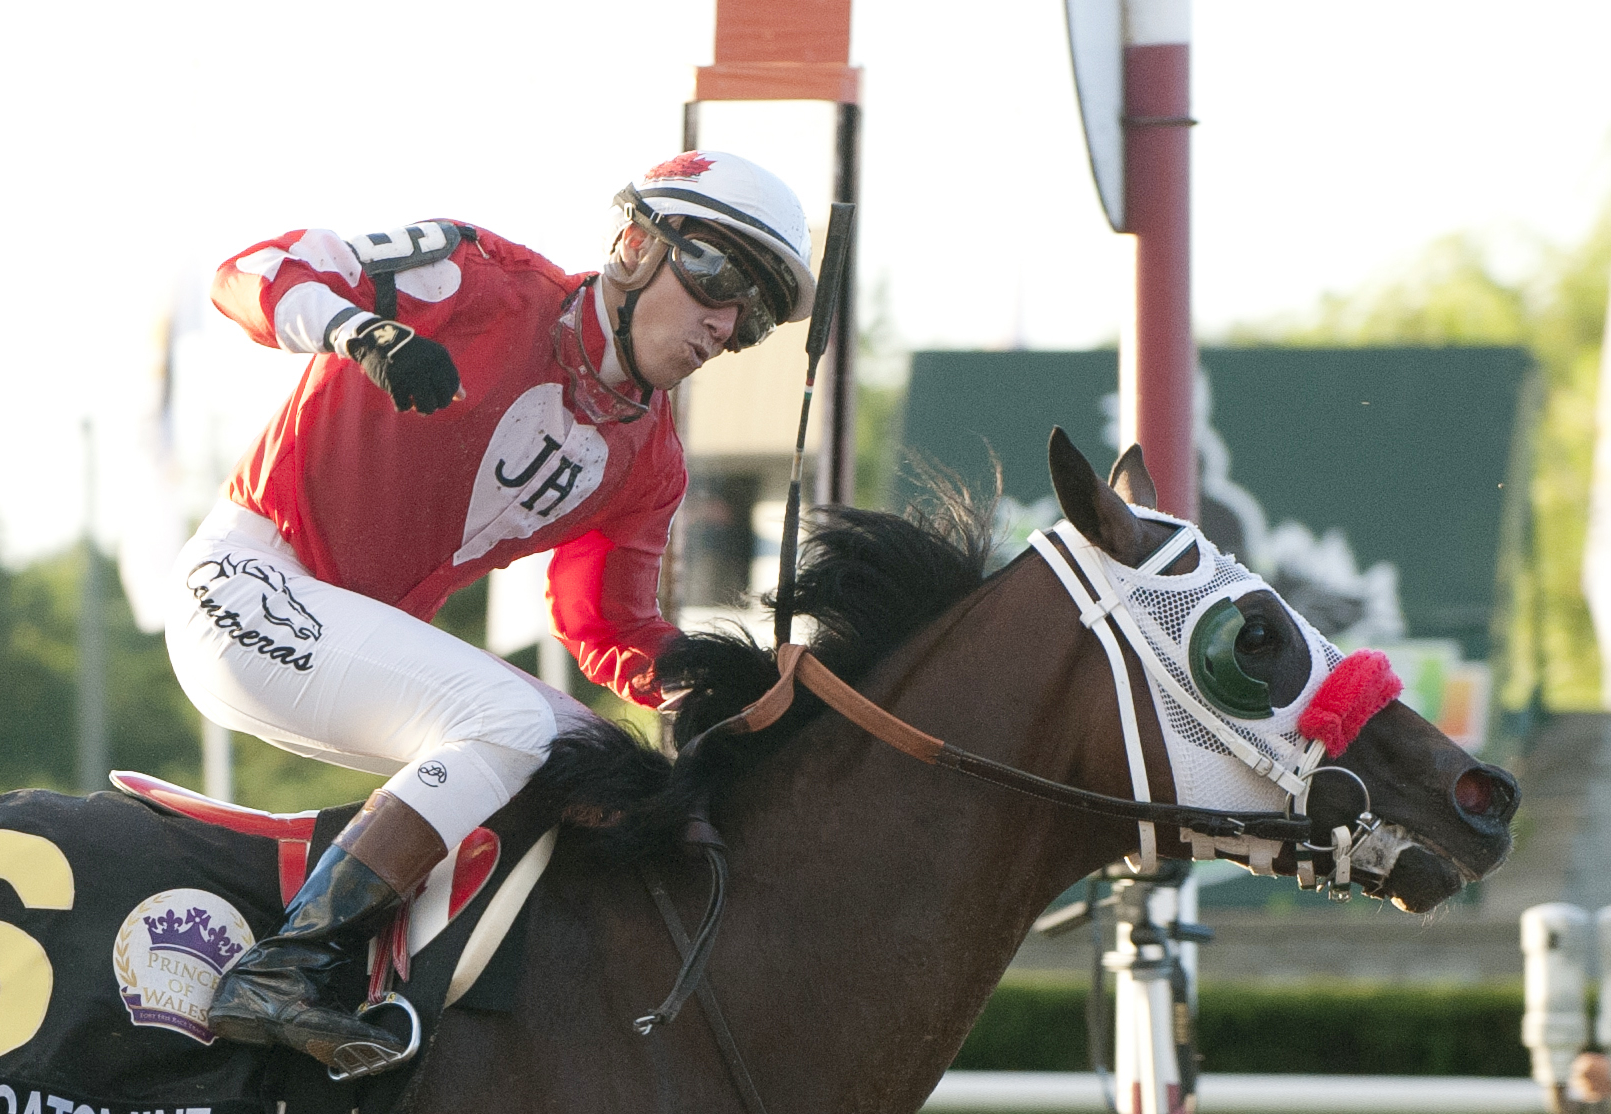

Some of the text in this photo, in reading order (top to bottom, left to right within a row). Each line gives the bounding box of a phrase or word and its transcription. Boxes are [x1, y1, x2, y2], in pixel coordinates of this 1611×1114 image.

[147, 951, 221, 990] PRINCE
[168, 978, 195, 998] OF
[142, 986, 209, 1023] WALES
